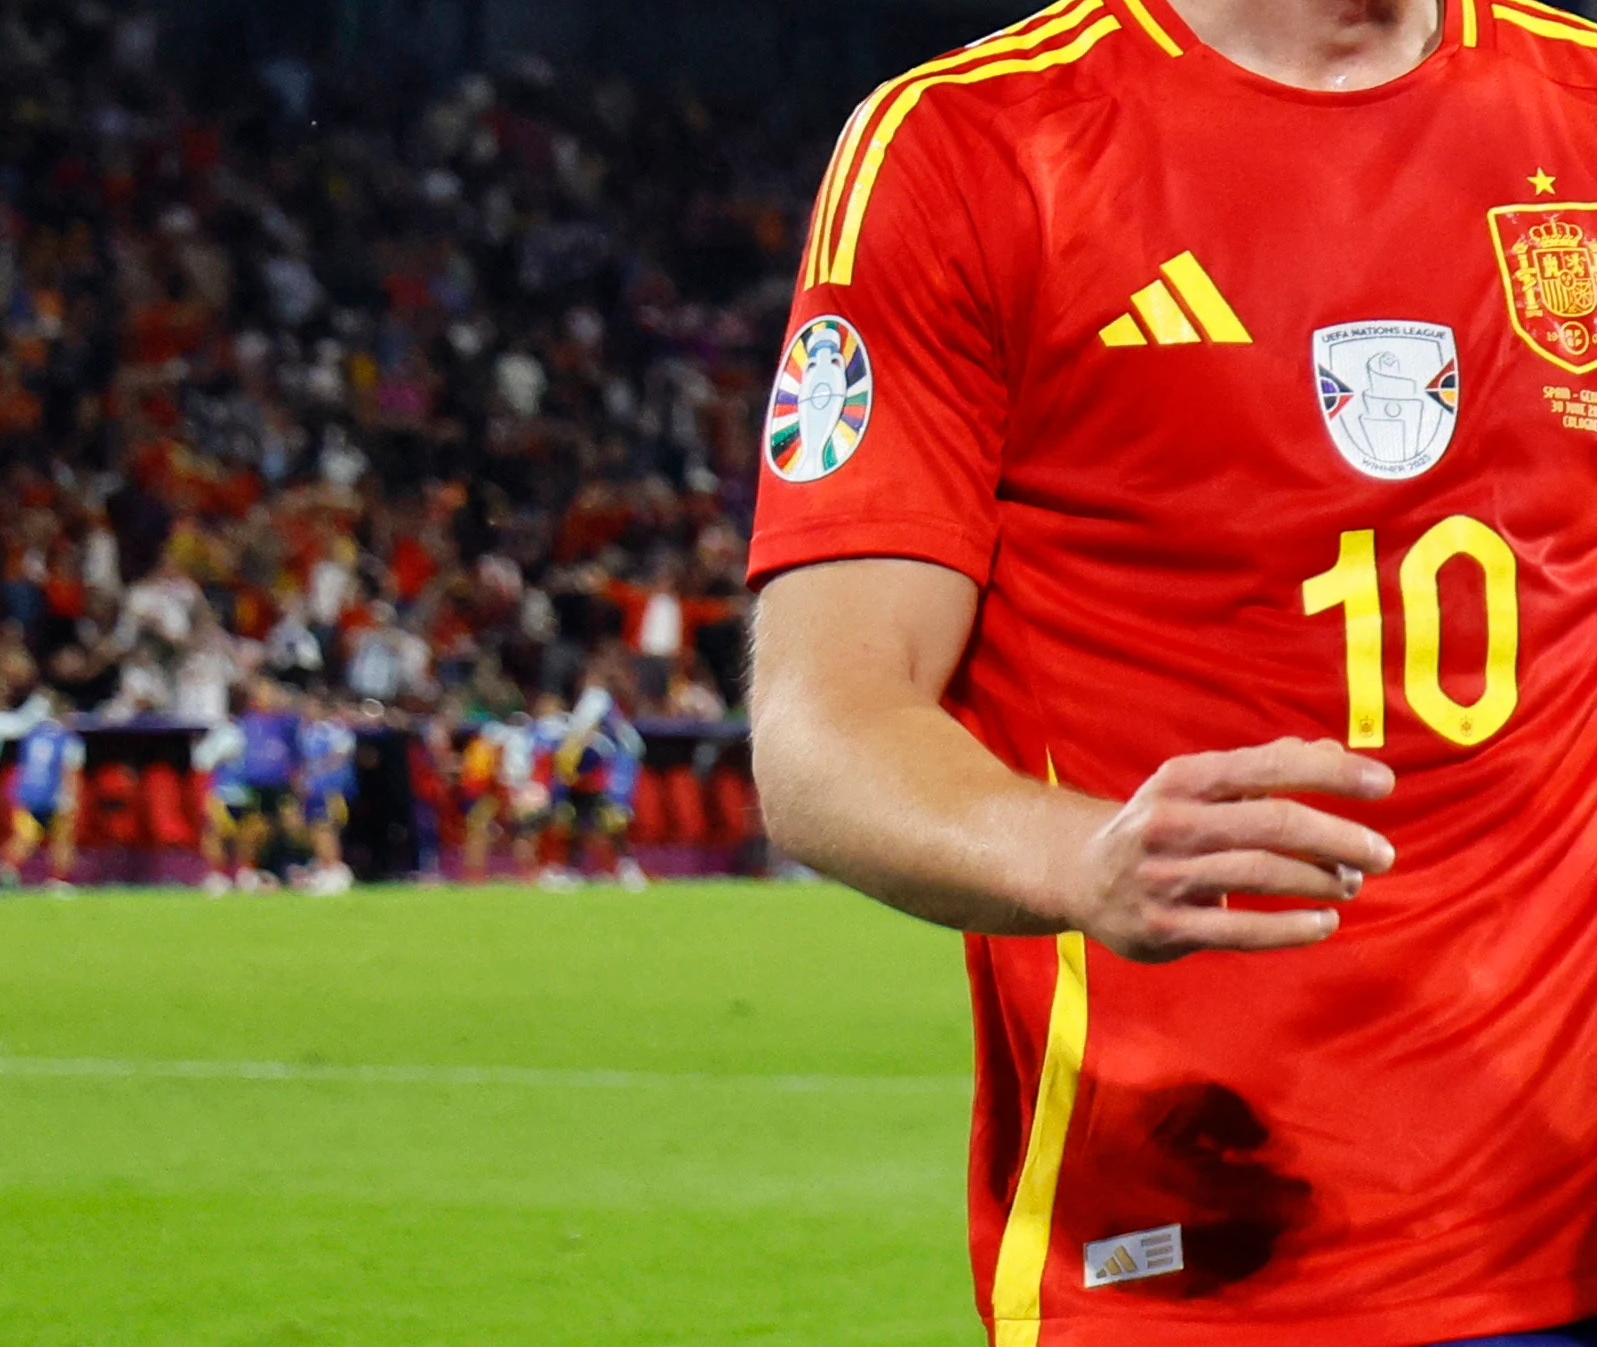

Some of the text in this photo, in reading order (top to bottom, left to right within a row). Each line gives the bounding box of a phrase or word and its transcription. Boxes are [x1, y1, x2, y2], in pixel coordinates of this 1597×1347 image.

[1322, 326, 1447, 343] UEFA NATIONS LEAGUE
[1551, 400, 1564, 413] 30
[1362, 457, 1405, 473] WINNER
[1302, 514, 1518, 749] 10
